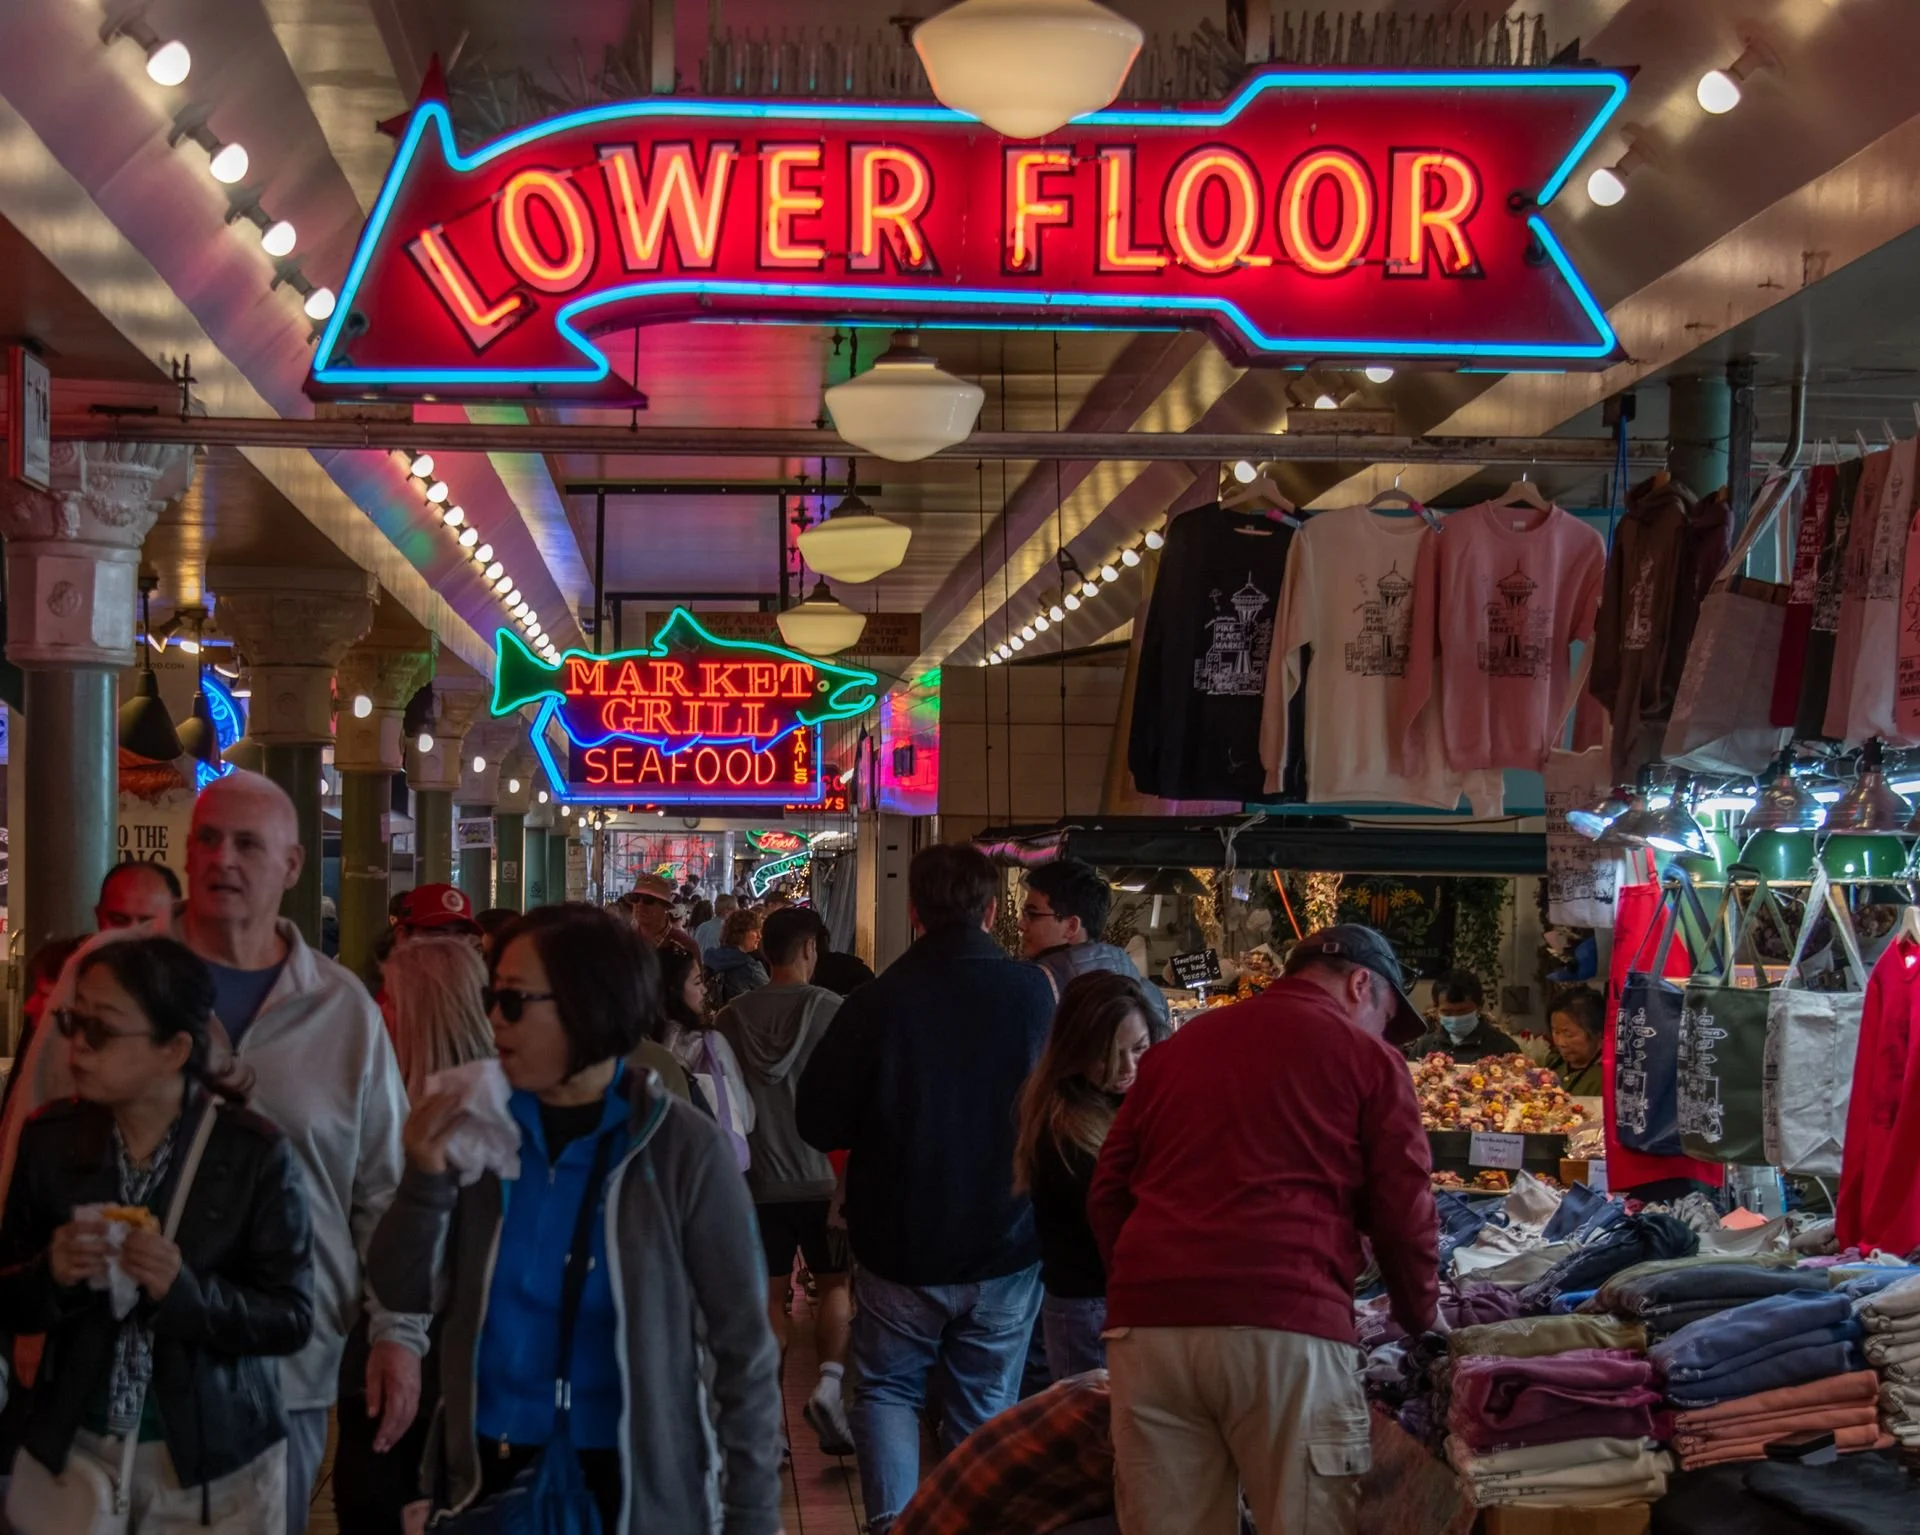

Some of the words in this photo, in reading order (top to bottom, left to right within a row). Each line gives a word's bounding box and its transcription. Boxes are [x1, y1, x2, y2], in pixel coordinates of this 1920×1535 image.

[404, 141, 938, 354] LOWER
[1001, 143, 1484, 280] FLOOR
[706, 616, 728, 625] NOT
[748, 616, 776, 625] PUB
[1216, 624, 1235, 632] PIKE
[1216, 632, 1242, 640] PLACE
[565, 658, 814, 699] MARKET
[602, 697, 779, 737] GRILL
[584, 747, 777, 785] SEAFOOD
[118, 824, 128, 848] O
[134, 824, 169, 848] THE
[758, 832, 799, 849] Fresh
